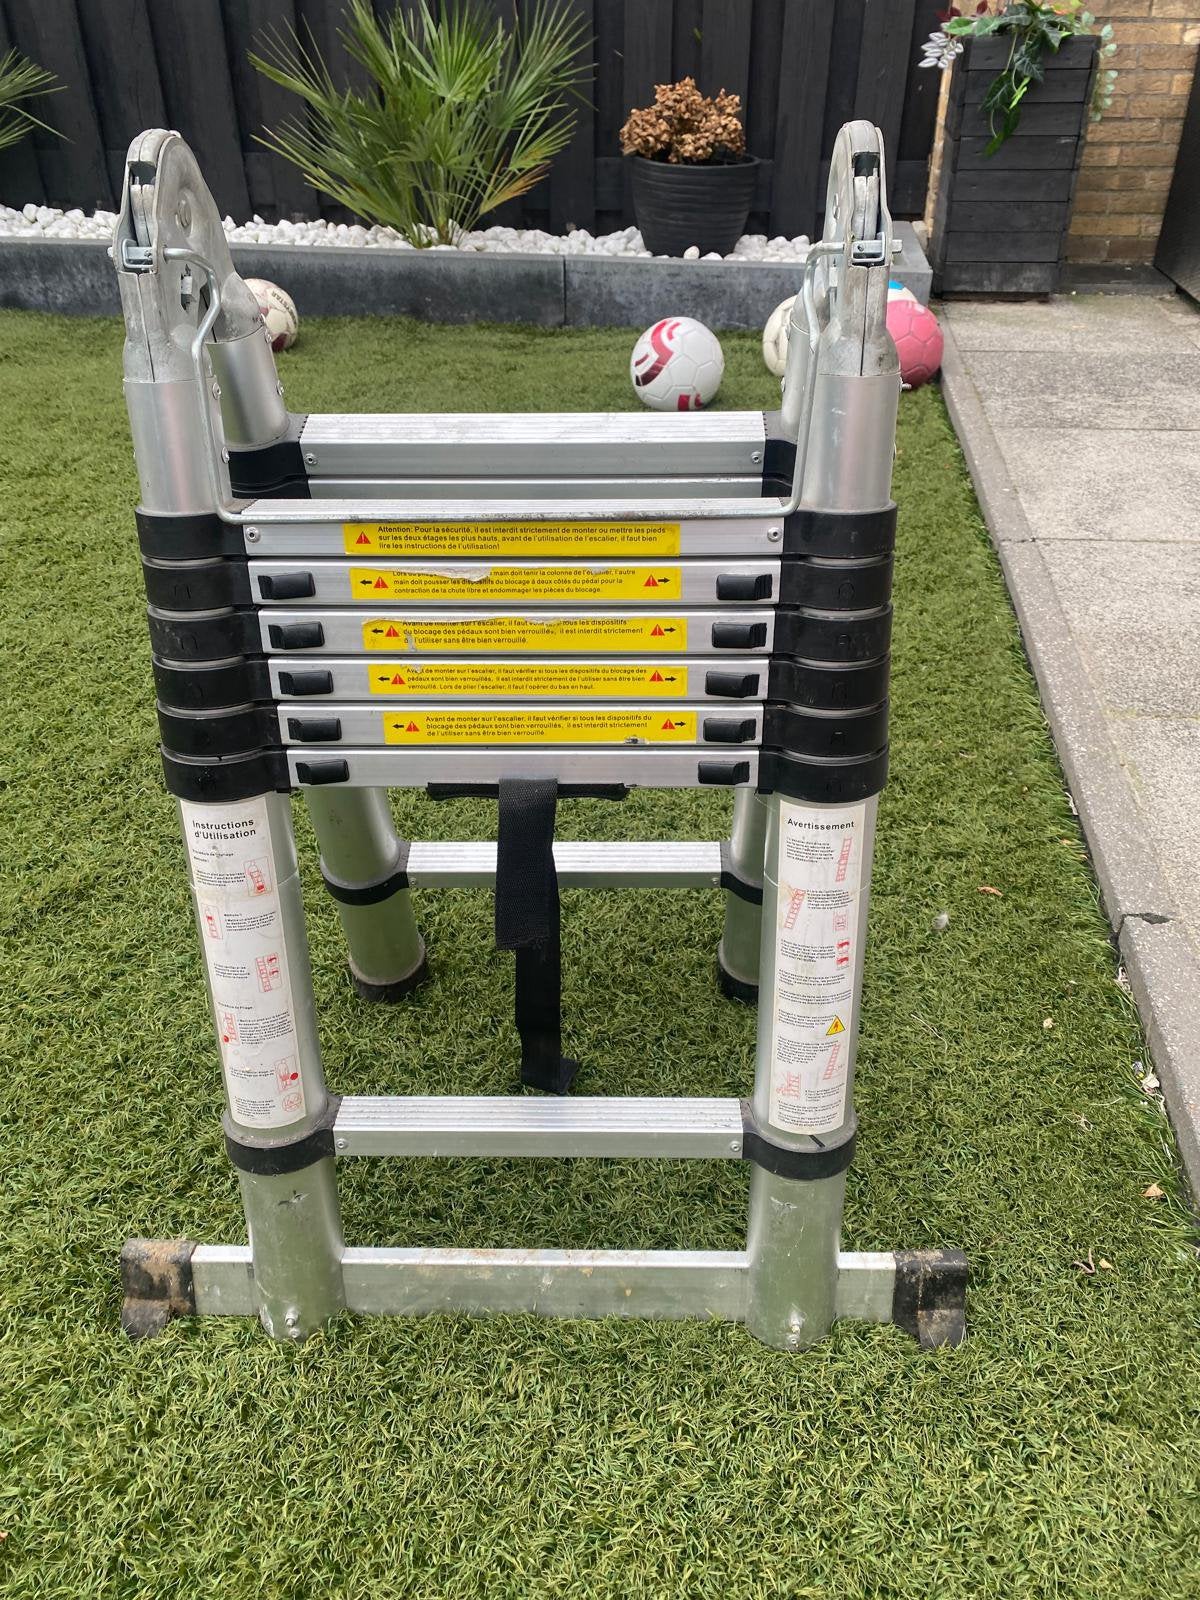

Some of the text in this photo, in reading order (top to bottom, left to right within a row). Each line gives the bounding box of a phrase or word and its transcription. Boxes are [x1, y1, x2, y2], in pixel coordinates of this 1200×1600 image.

[192, 818, 254, 830] Instructions
[787, 818, 855, 830] Avertissement
[194, 829, 256, 840] d'Utilisation
